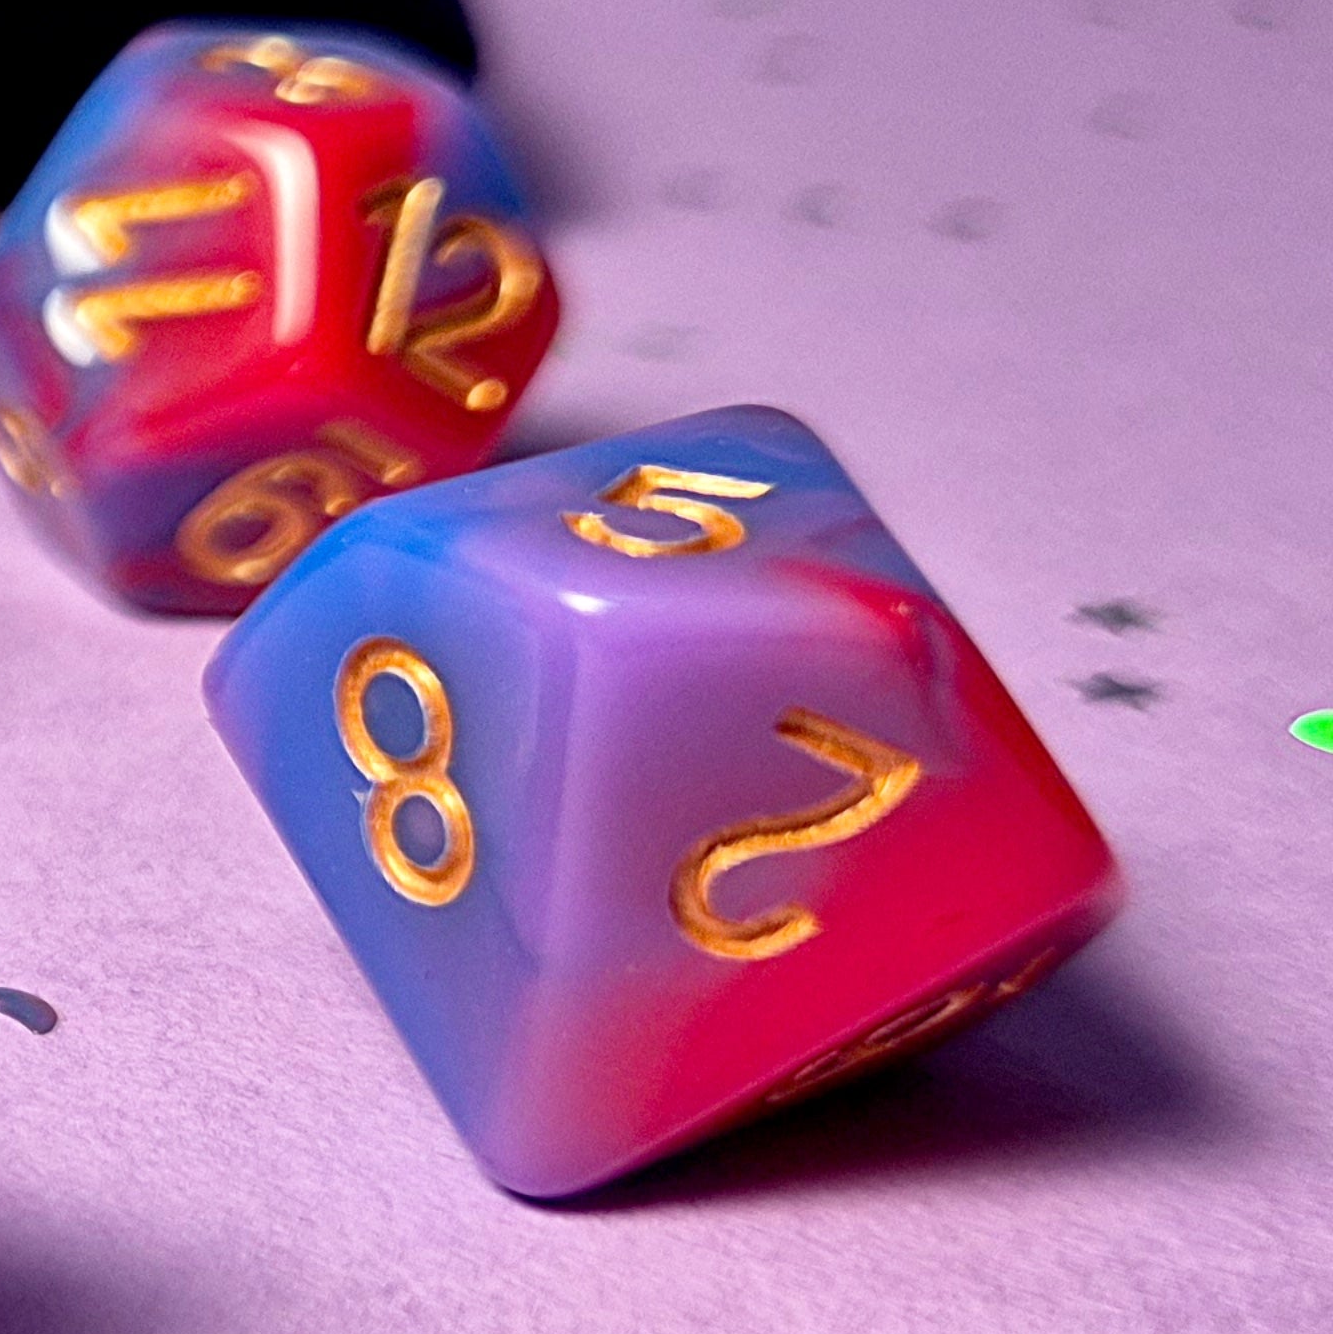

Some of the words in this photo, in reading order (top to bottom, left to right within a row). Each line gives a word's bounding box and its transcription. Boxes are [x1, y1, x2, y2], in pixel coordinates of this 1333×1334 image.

[66, 171, 264, 362] 11
[360, 177, 545, 412] 12
[561, 465, 774, 558] 5
[334, 636, 474, 906] 8
[669, 706, 921, 961] 2
